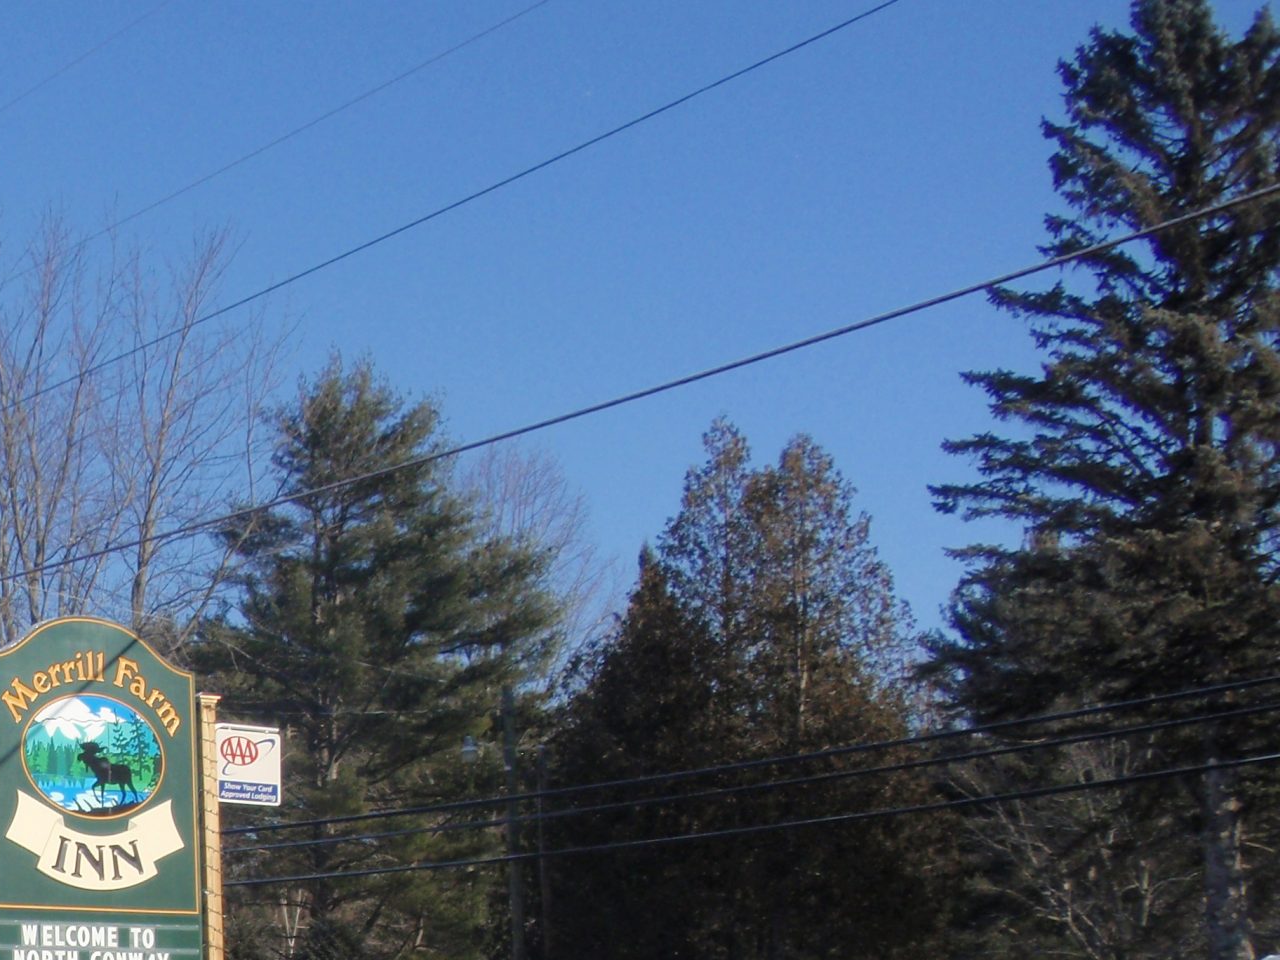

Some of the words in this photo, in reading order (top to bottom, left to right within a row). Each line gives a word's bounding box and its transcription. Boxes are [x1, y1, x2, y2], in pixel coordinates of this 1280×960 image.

[1, 650, 105, 723] Merrill
[113, 656, 183, 737] Farm
[224, 736, 255, 766] AAA
[221, 790, 250, 799] Approved
[251, 792, 276, 801] Lodging
[224, 782, 241, 790] Show
[242, 784, 257, 792] Your
[51, 835, 145, 881] INN
[22, 924, 118, 948] WELCOME
[130, 927, 155, 949] TO
